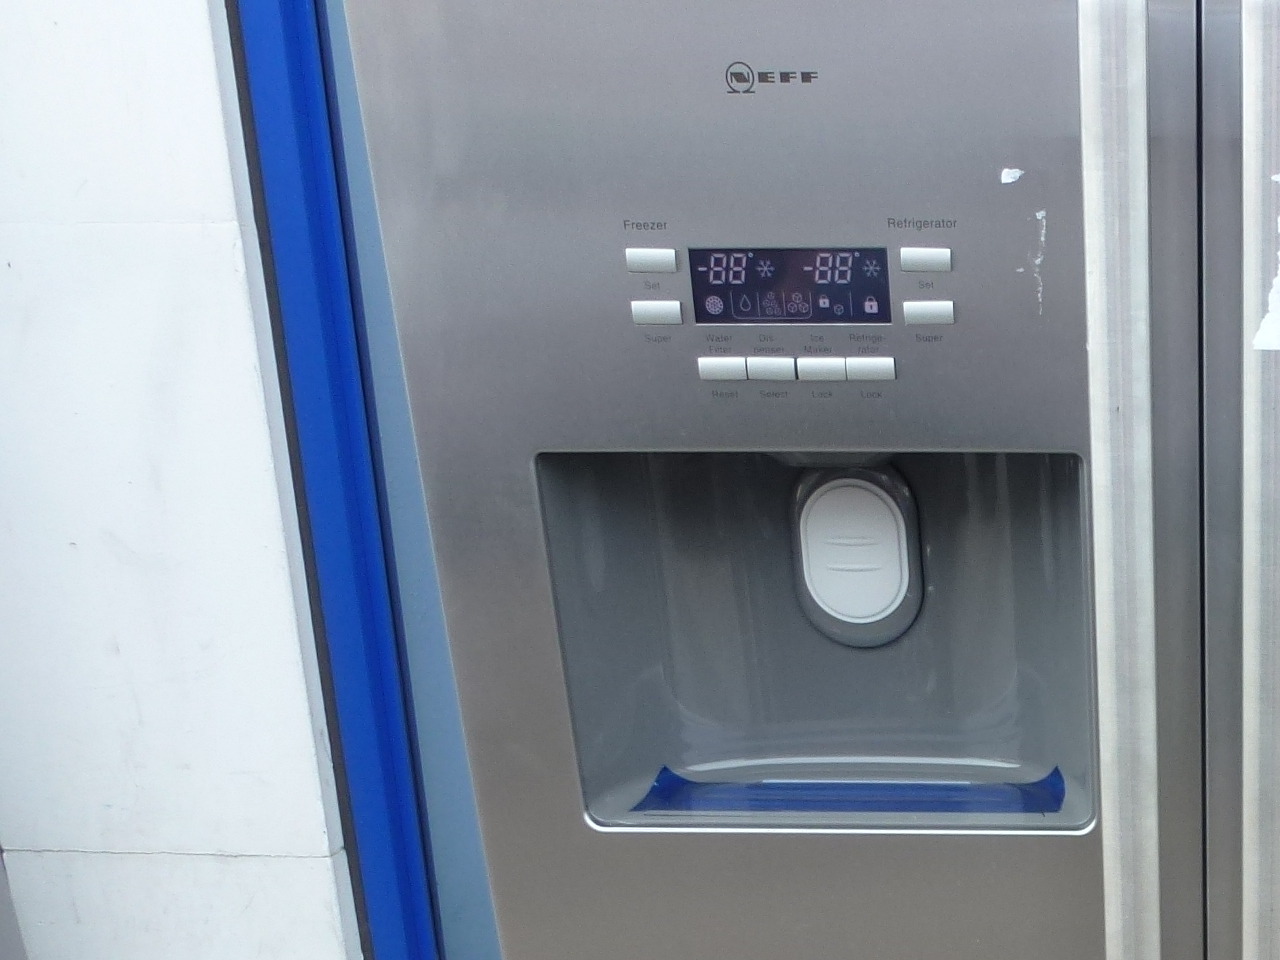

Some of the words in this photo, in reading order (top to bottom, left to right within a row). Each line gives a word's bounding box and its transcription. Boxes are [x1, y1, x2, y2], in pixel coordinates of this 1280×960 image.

[725, 61, 819, 94] NEFF
[623, 219, 668, 231] Freezer
[886, 217, 958, 231] Refrigerator
[918, 280, 934, 289] Set
